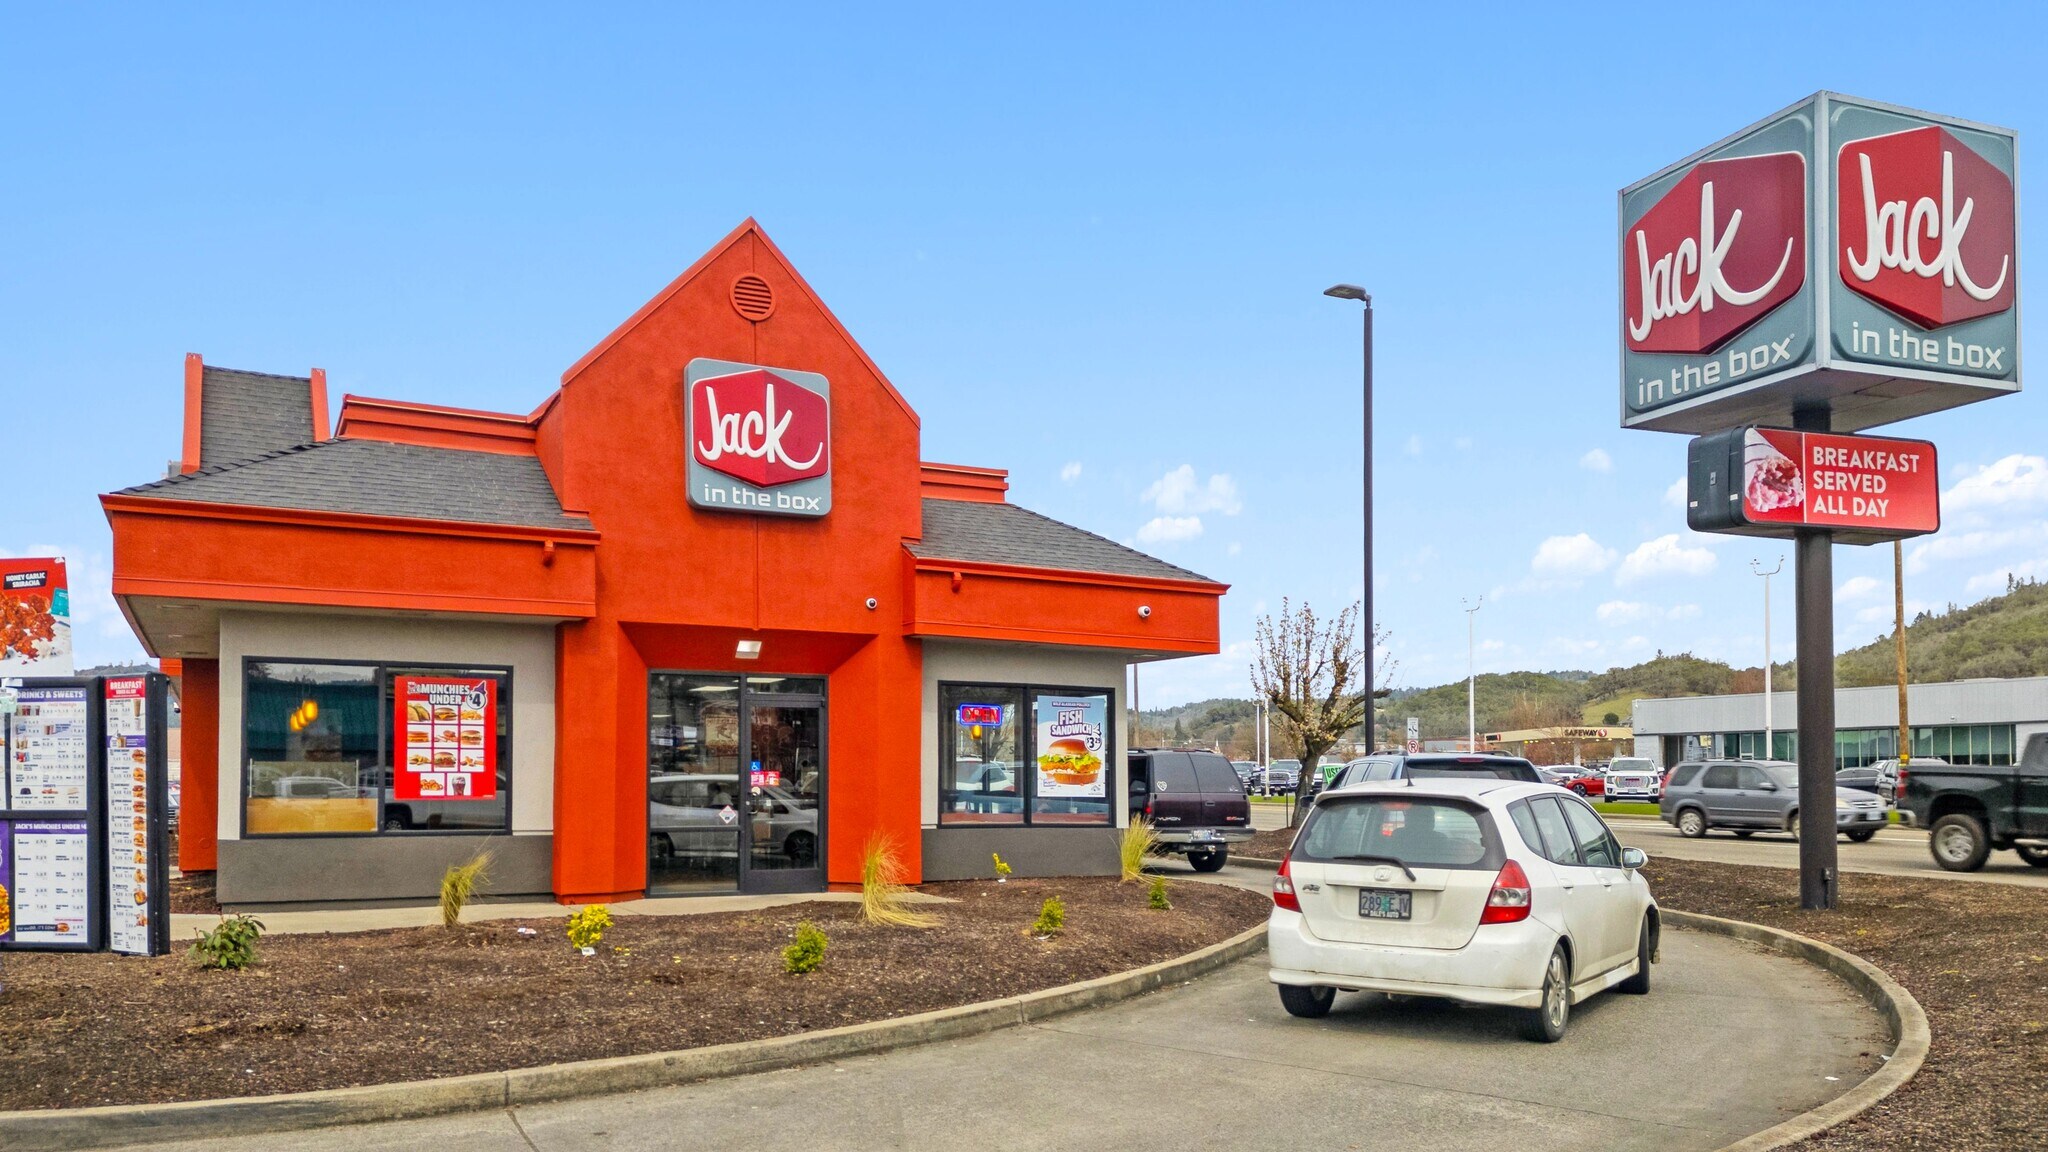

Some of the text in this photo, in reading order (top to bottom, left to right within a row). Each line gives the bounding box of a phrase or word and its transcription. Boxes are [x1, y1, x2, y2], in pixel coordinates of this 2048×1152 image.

[1847, 151, 2009, 302] Jack
[1629, 181, 1794, 342] Jack
[1852, 321, 2002, 371] in the box
[1638, 335, 1791, 405] in the box
[698, 383, 824, 471] Jack
[1812, 446, 1920, 473] BREAKFAST
[1812, 470, 1887, 494] SERVED
[704, 484, 820, 511] in the box
[1813, 494, 1890, 518] ALL DAY
[12, 579, 40, 588] SRIRACHA
[26, 572, 46, 580] GARLIC
[110, 681, 142, 690] BREAKFAST
[421, 684, 470, 695] MUNCHIES
[17, 690, 45, 698] DRINKS
[45, 690, 52, 698] &
[53, 690, 83, 698] SWEETS
[429, 694, 462, 704] UNDER
[469, 693, 481, 707] $4
[962, 707, 999, 723] OPEN
[1059, 710, 1083, 725] FISH
[1051, 724, 1092, 735] SANDWICH
[1564, 729, 1598, 737] SAFEWAY
[1361, 896, 1381, 910] 289
